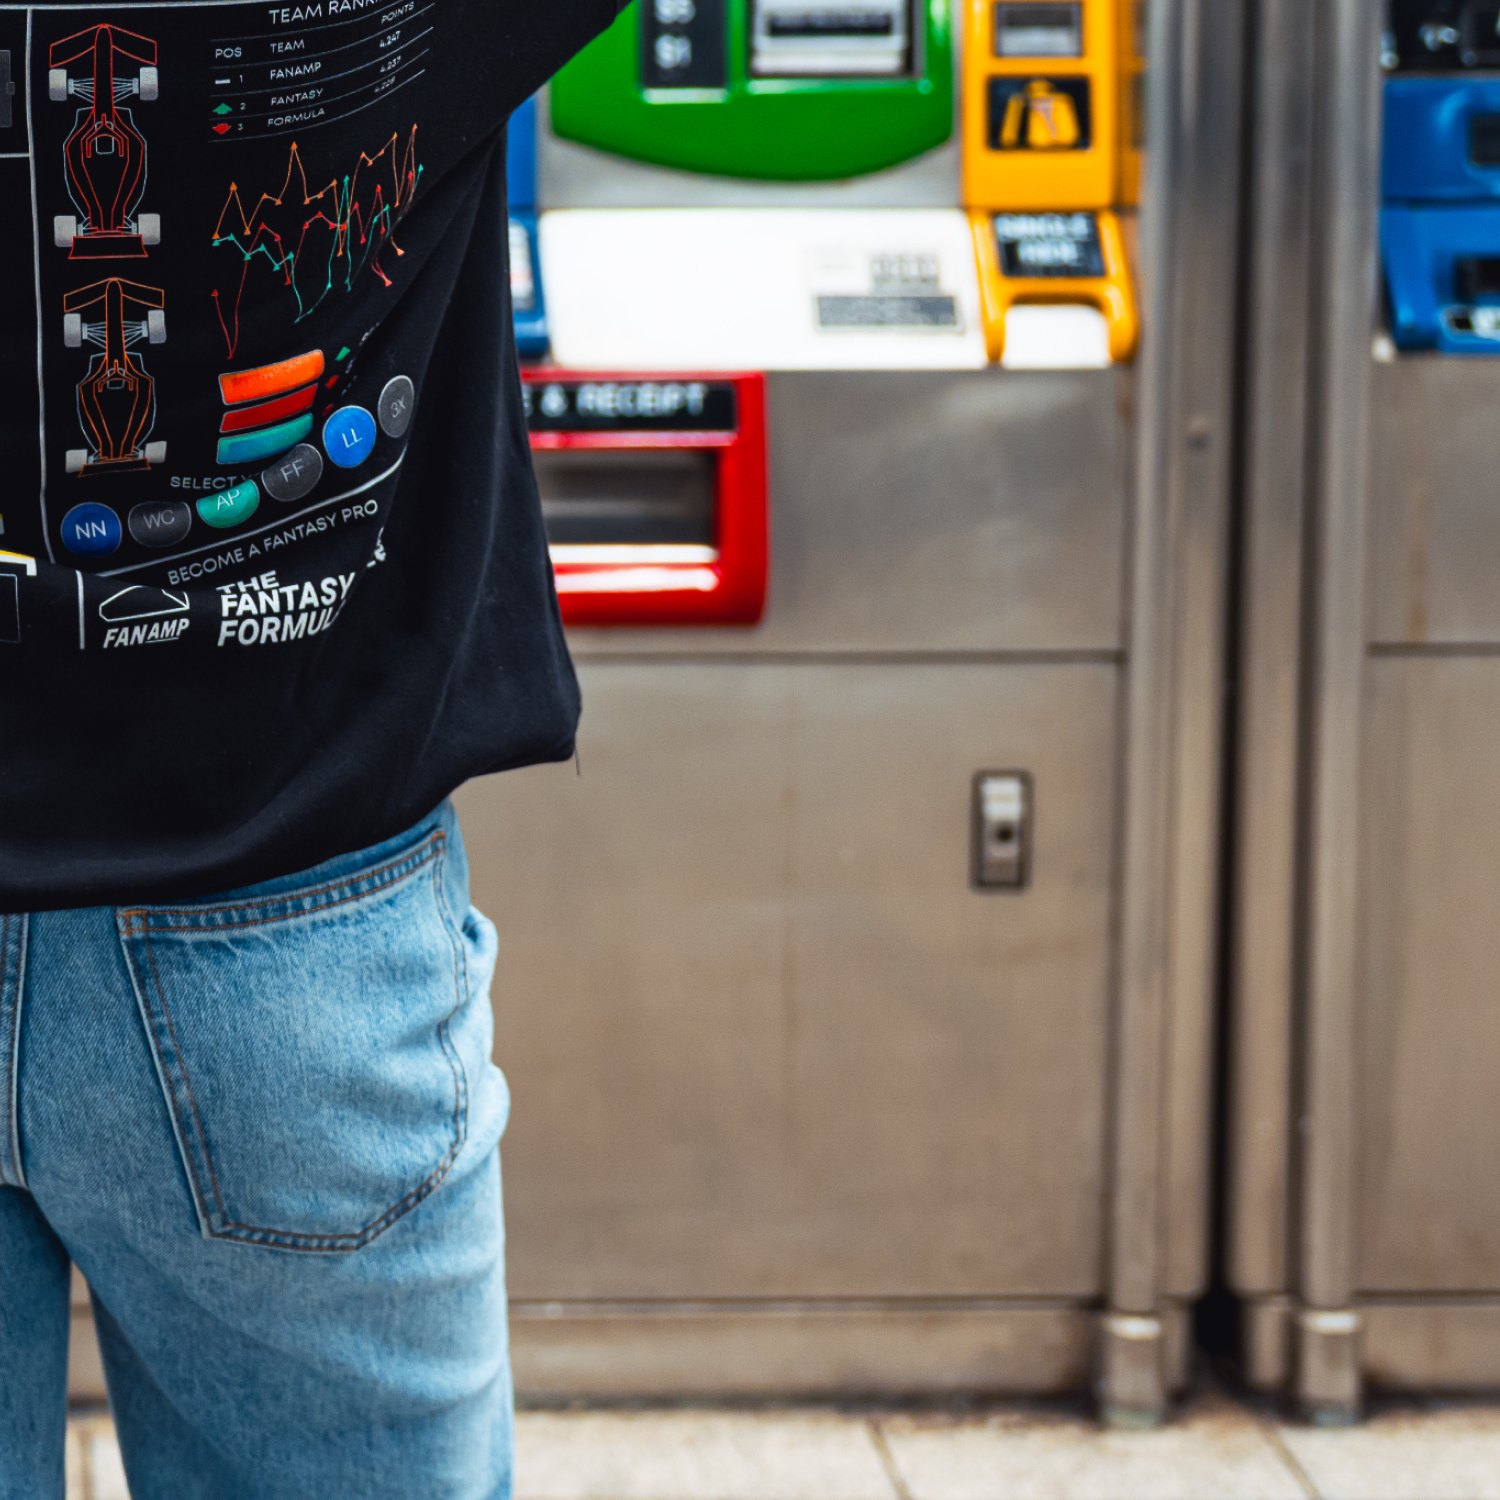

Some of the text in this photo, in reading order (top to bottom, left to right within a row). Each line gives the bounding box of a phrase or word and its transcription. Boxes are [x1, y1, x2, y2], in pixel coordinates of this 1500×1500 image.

[268, 3, 322, 24] TEAM
[215, 1, 414, 59] POS TEAM POINTS
[239, 74, 243, 83] 1
[270, 62, 322, 80] FANAMP
[240, 102, 246, 110] 2
[270, 88, 324, 106] FANTASY
[237, 123, 243, 131] 3
[267, 107, 326, 127] FORMULA
[342, 428, 363, 448] LL
[280, 458, 304, 483] FF
[170, 476, 237, 489] SELECT
[217, 488, 240, 511] AP
[143, 510, 175, 529] WC
[75, 523, 107, 541] NN
[168, 499, 379, 586] BECOME A FANTASY PRO
[216, 570, 279, 594] THE
[220, 572, 356, 618] FANTASY
[102, 618, 190, 649] FANAMP
